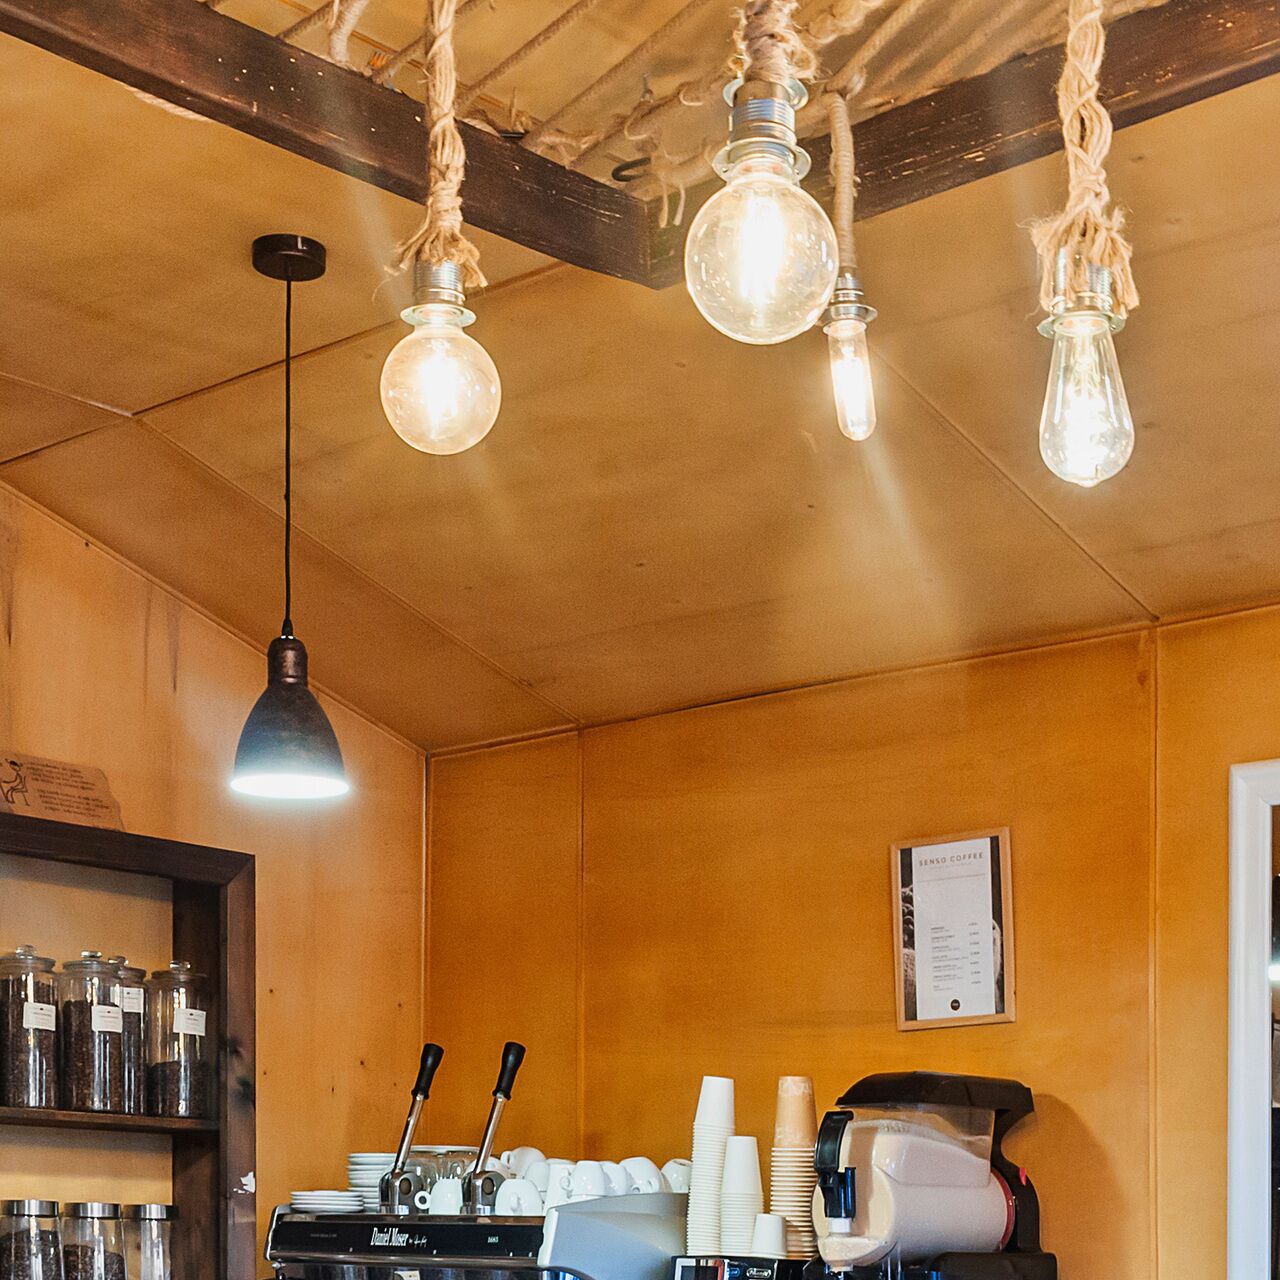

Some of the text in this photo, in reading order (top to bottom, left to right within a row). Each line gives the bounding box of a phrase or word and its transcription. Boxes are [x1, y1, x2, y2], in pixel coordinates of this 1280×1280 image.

[919, 857, 947, 866] SENSO
[950, 852, 983, 862] COFFEE
[370, 1227, 391, 1246] Daniel
[389, 1228, 409, 1247] Moser
